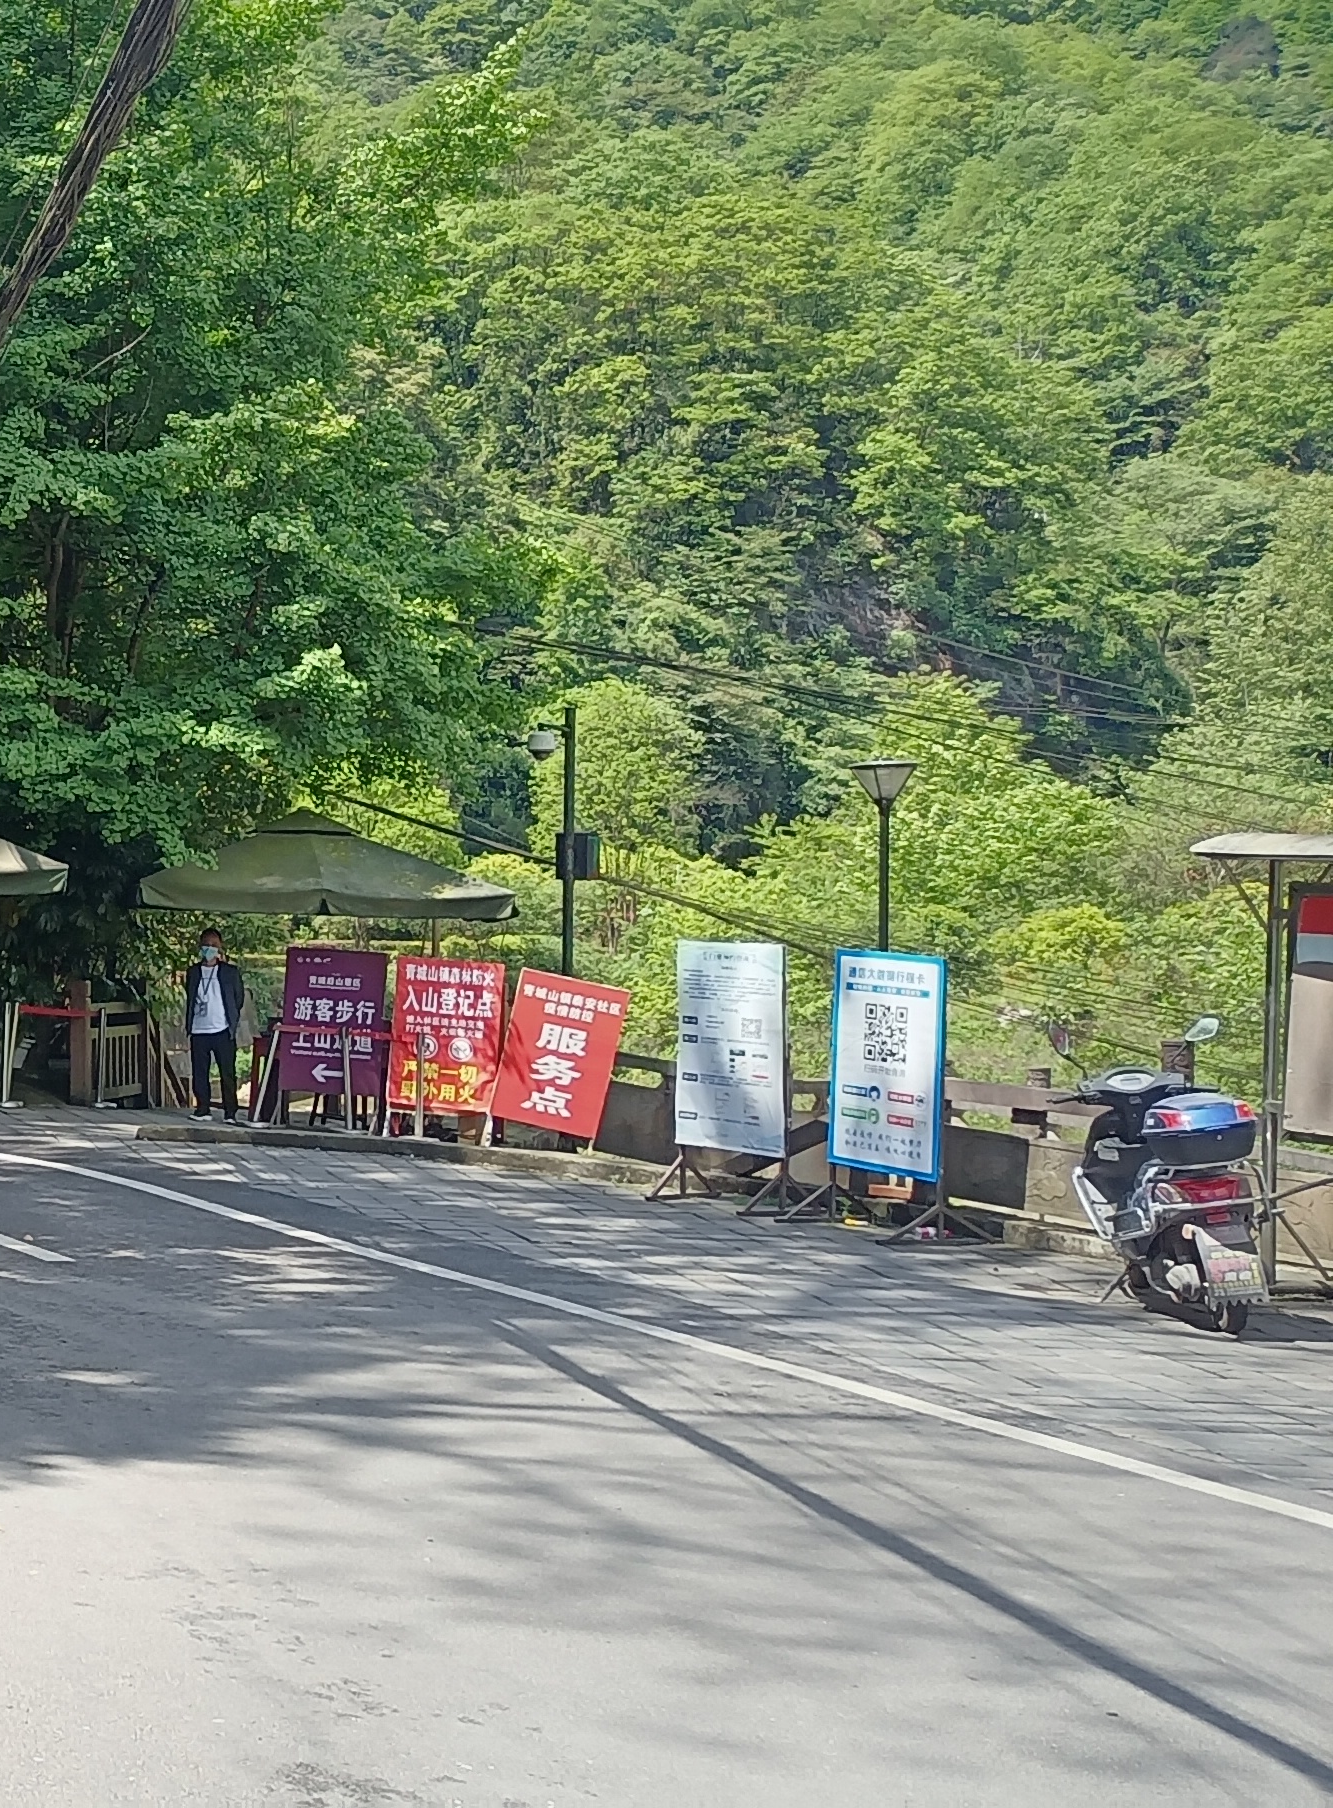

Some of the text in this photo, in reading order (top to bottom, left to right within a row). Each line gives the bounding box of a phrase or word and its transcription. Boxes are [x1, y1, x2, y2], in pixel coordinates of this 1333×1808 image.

[294, 997, 375, 1024] 游客步行
[403, 985, 494, 1018] 入山登记点
[544, 1002, 595, 1023] 疫情防控
[402, 1060, 477, 1084] 严禁一切
[520, 1023, 588, 1118] 服务点
[400, 1080, 476, 1104] 野外用火
